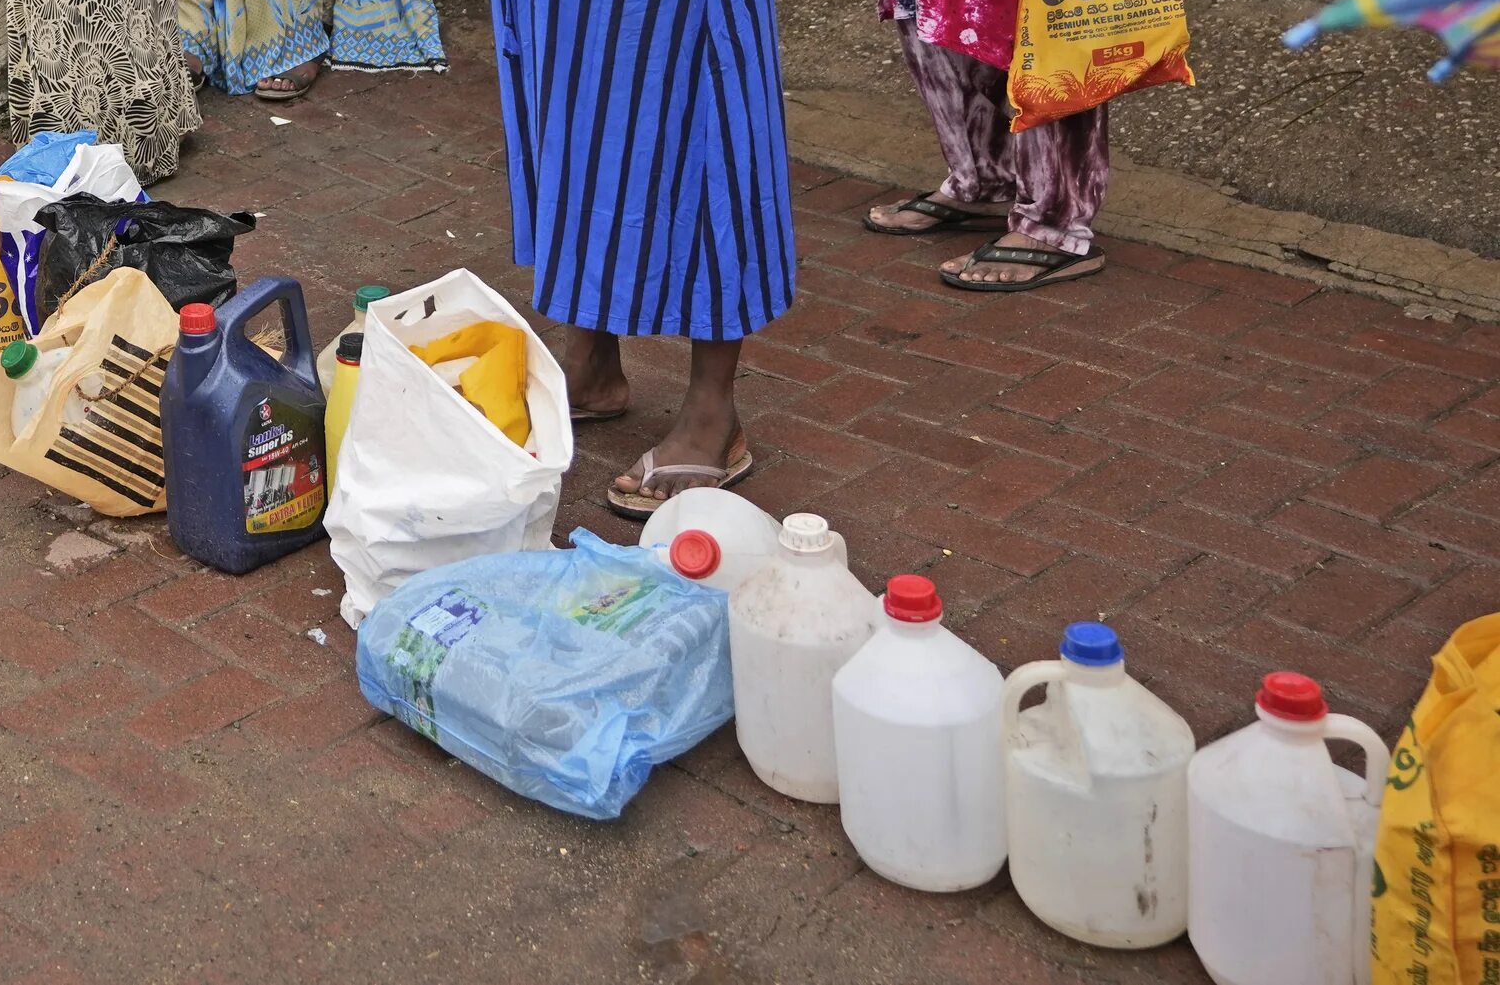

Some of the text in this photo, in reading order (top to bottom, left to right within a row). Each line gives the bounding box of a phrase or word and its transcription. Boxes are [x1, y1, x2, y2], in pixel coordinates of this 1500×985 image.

[1047, 2, 1185, 32] PREMIUM KEERI SAMBA RICE
[1022, 52, 1035, 71] 5kg
[1103, 45, 1134, 58] 5kg
[248, 430, 293, 459] Super DS
[250, 424, 285, 447] Lanka
[268, 446, 290, 462] 15W-40
[270, 504, 295, 526] EXTRA
